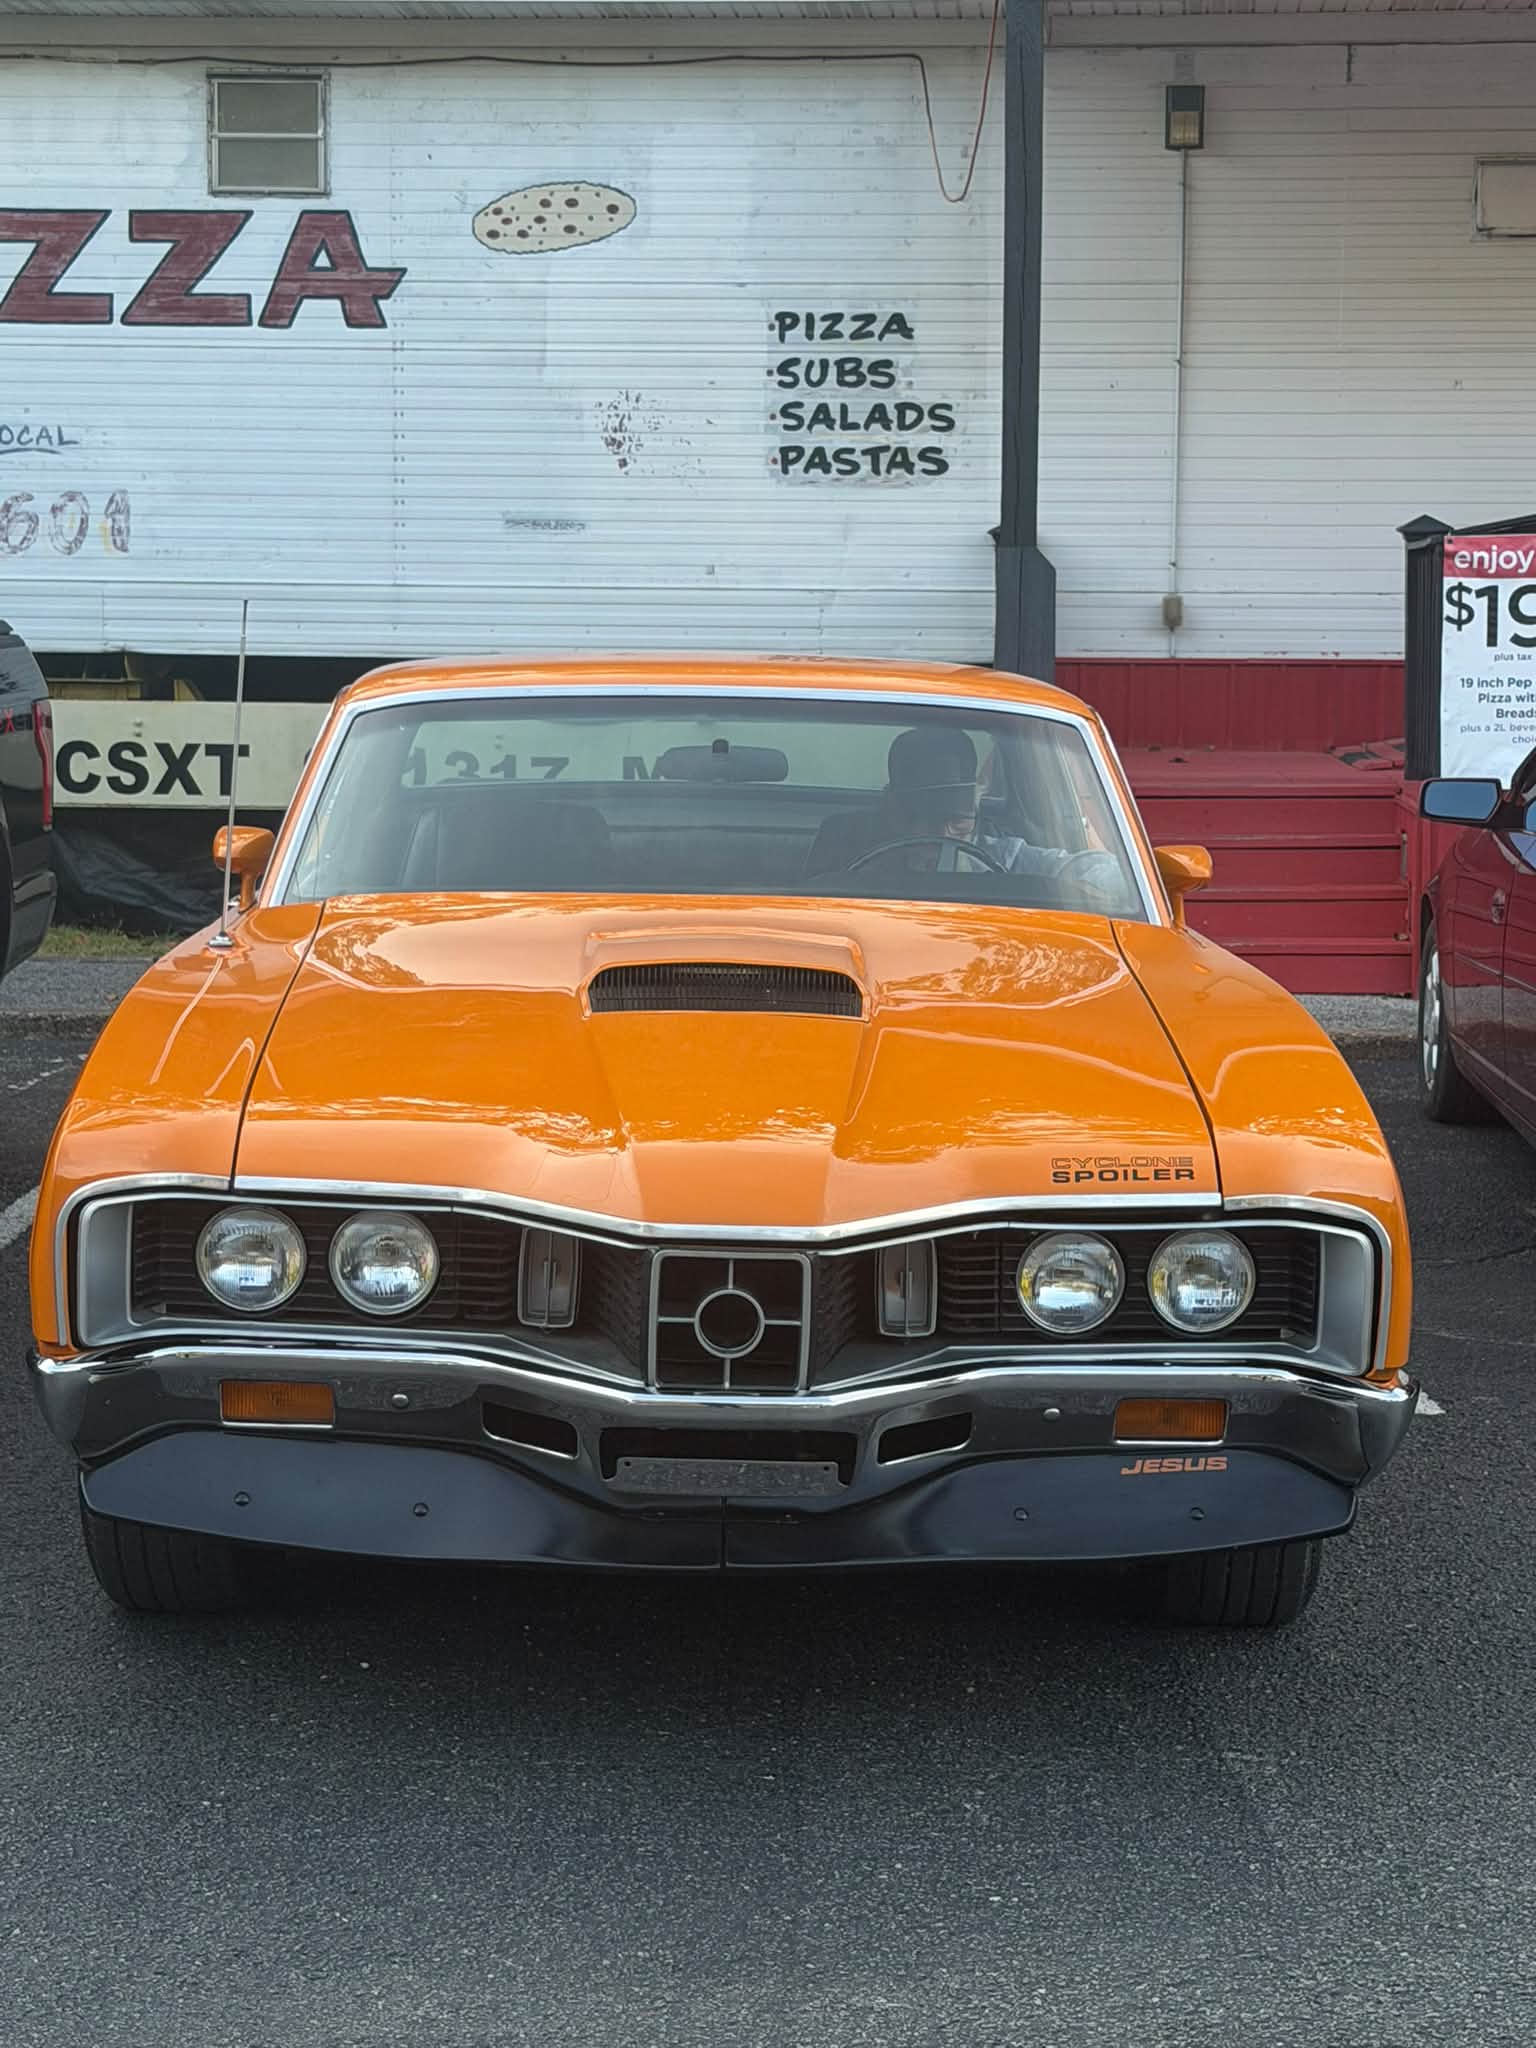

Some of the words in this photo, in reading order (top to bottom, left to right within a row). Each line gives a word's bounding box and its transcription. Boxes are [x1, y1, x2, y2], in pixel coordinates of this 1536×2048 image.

[0, 209, 407, 329] ZZA
[774, 311, 914, 344] PIZZA
[776, 357, 896, 389] SUBS
[779, 401, 955, 433] SALADS
[0, 424, 79, 446] OCAL
[779, 445, 950, 477] PASTAS
[1454, 545, 1535, 574] enjoy
[1494, 653, 1514, 662] plus
[1517, 653, 1532, 661] tax
[1460, 677, 1474, 688] 19
[1477, 676, 1504, 688] inch
[1507, 677, 1532, 690] Pep
[1478, 692, 1512, 704] Pizza
[1515, 692, 1536, 703] wit
[1496, 708, 1536, 719] Bread
[1460, 723, 1481, 734] plus
[1512, 735, 1536, 744] choi
[55, 741, 250, 796] CSXT
[1051, 1156, 1194, 1169] CYCLONE
[1052, 1169, 1195, 1183] SPOILER
[1120, 1457, 1228, 1475] JESUS
